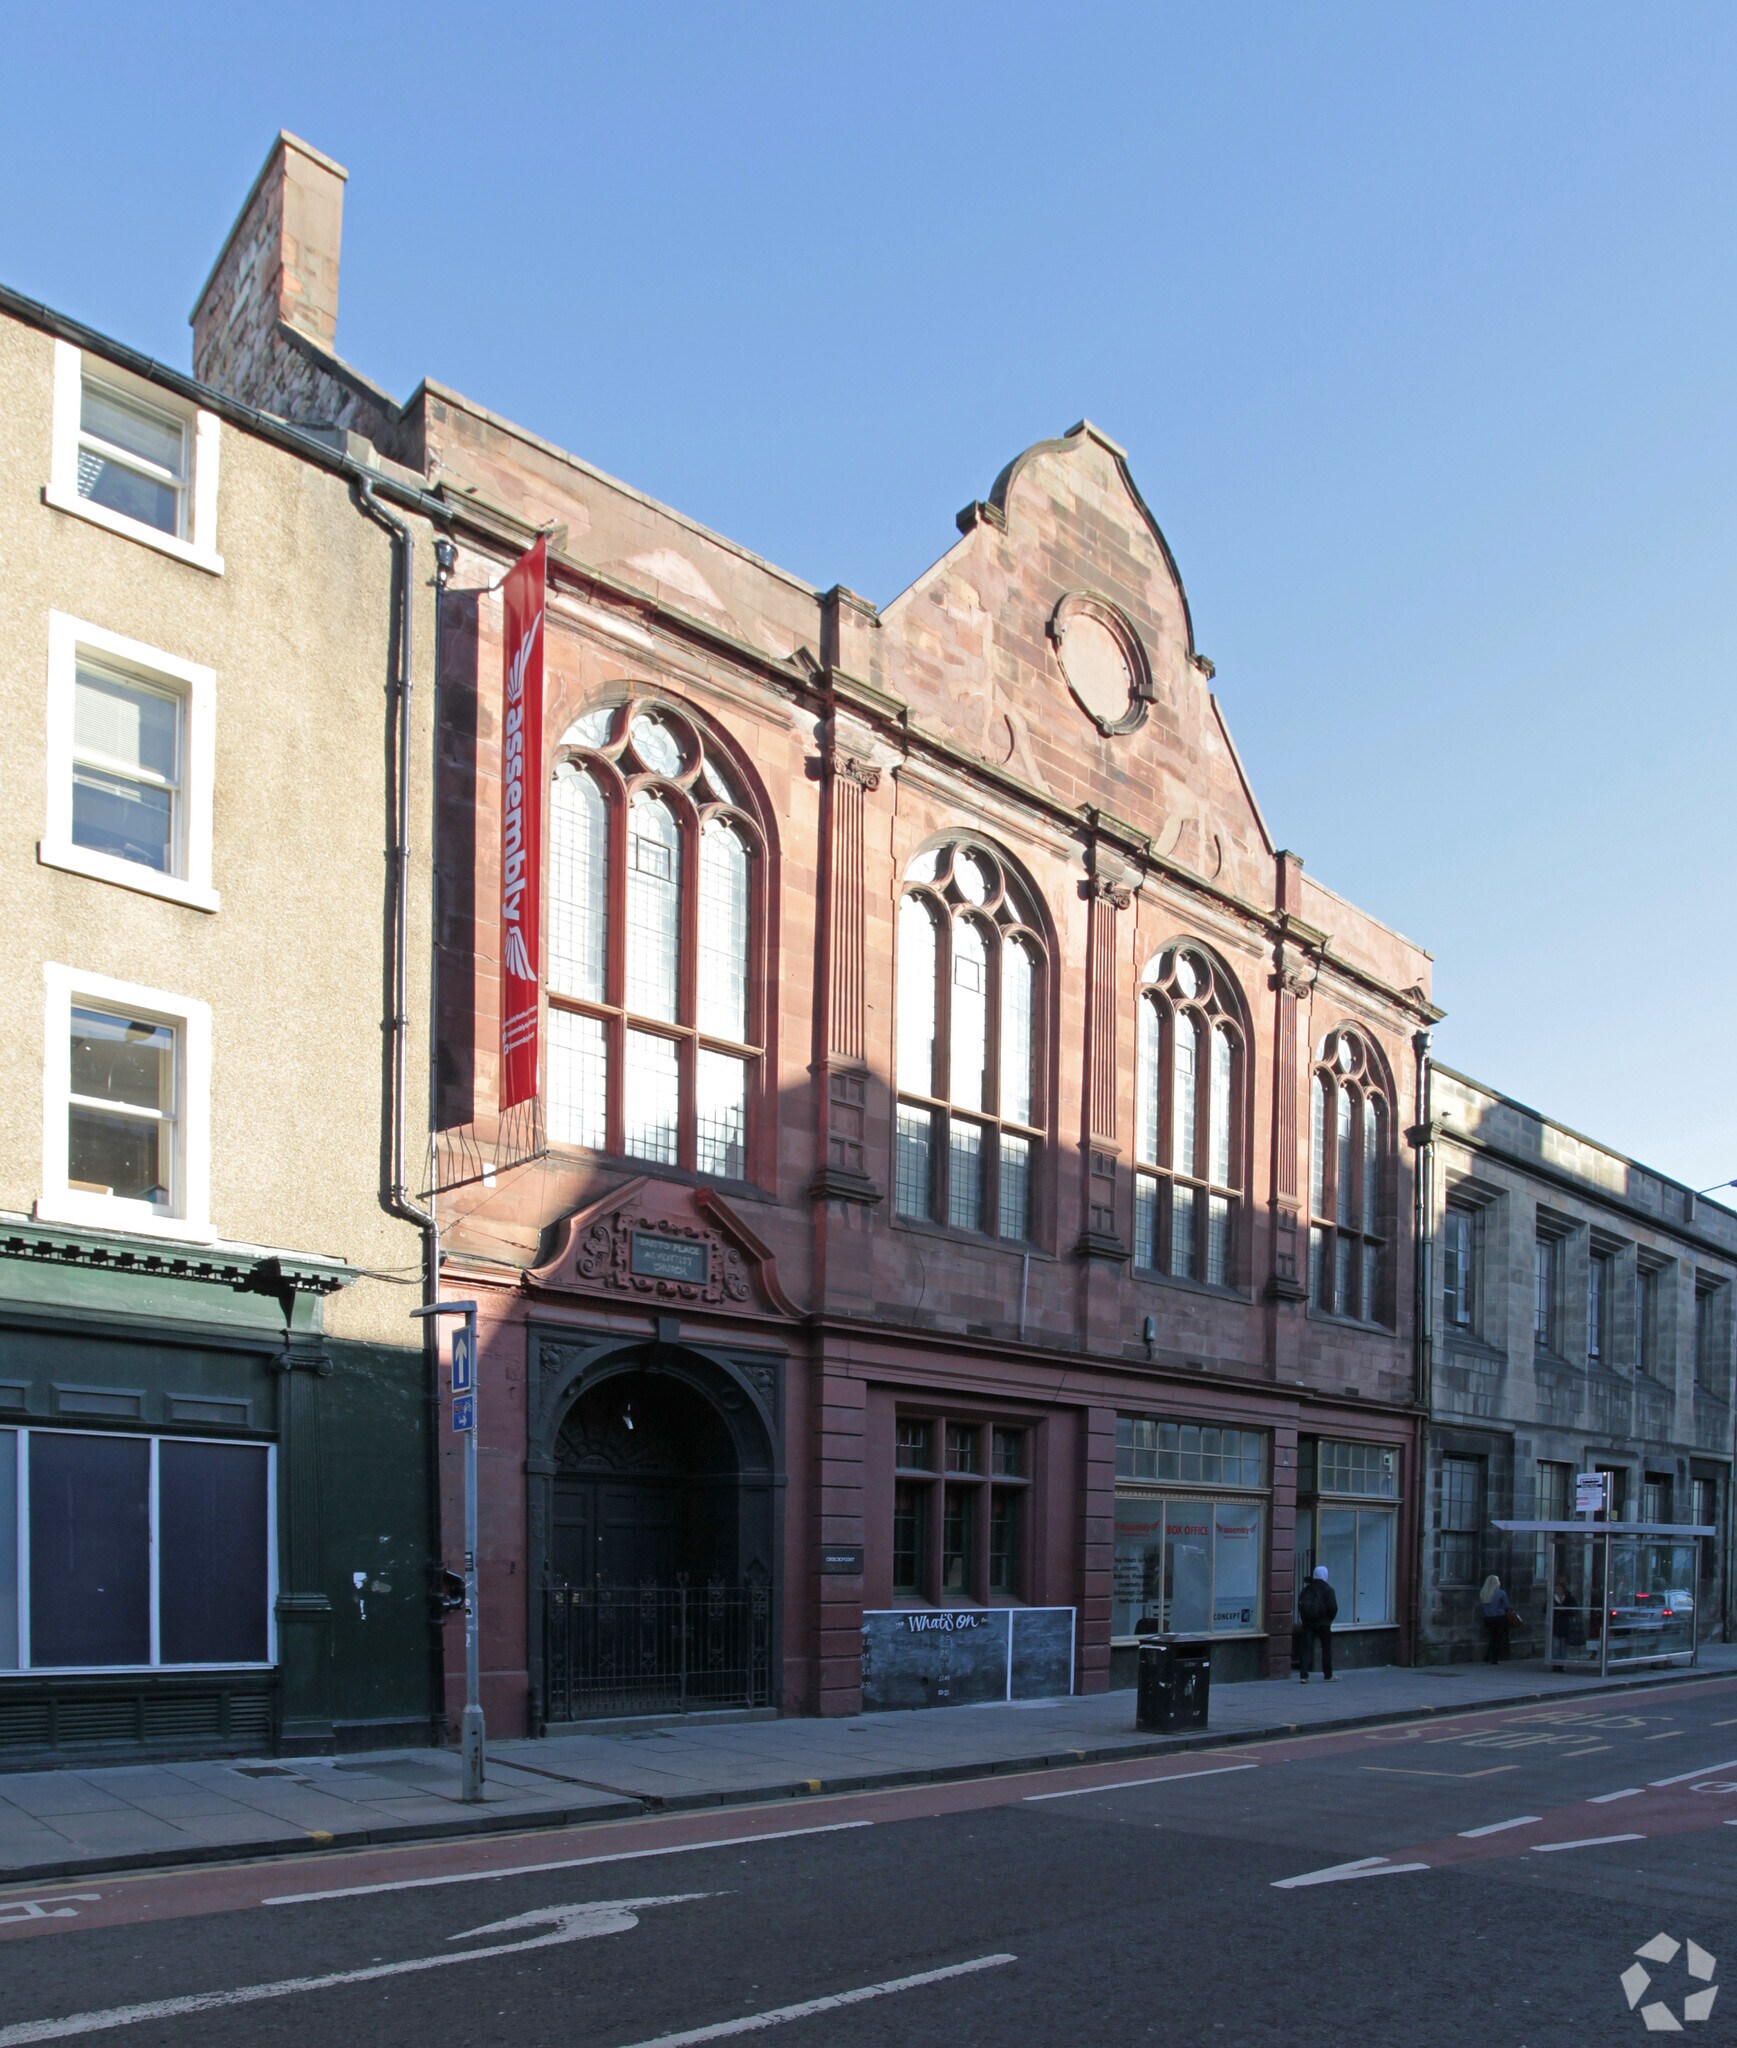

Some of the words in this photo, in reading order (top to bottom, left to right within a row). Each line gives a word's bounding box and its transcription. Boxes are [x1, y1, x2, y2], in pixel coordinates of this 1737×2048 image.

[503, 703, 525, 921] assembly
[672, 1244, 700, 1255] PLACE
[644, 1251, 693, 1266] ADVENTIST
[653, 1263, 687, 1276] CHURCH
[1119, 1524, 1150, 1532] assembly
[1167, 1525, 1183, 1535] BOX
[1184, 1525, 1209, 1536] OFFICE
[1223, 1526, 1249, 1535] assembly
[1213, 1612, 1240, 1621] CONCEPT
[1500, 1710, 1675, 1729] BUS
[1363, 1725, 1604, 1749] STOP
